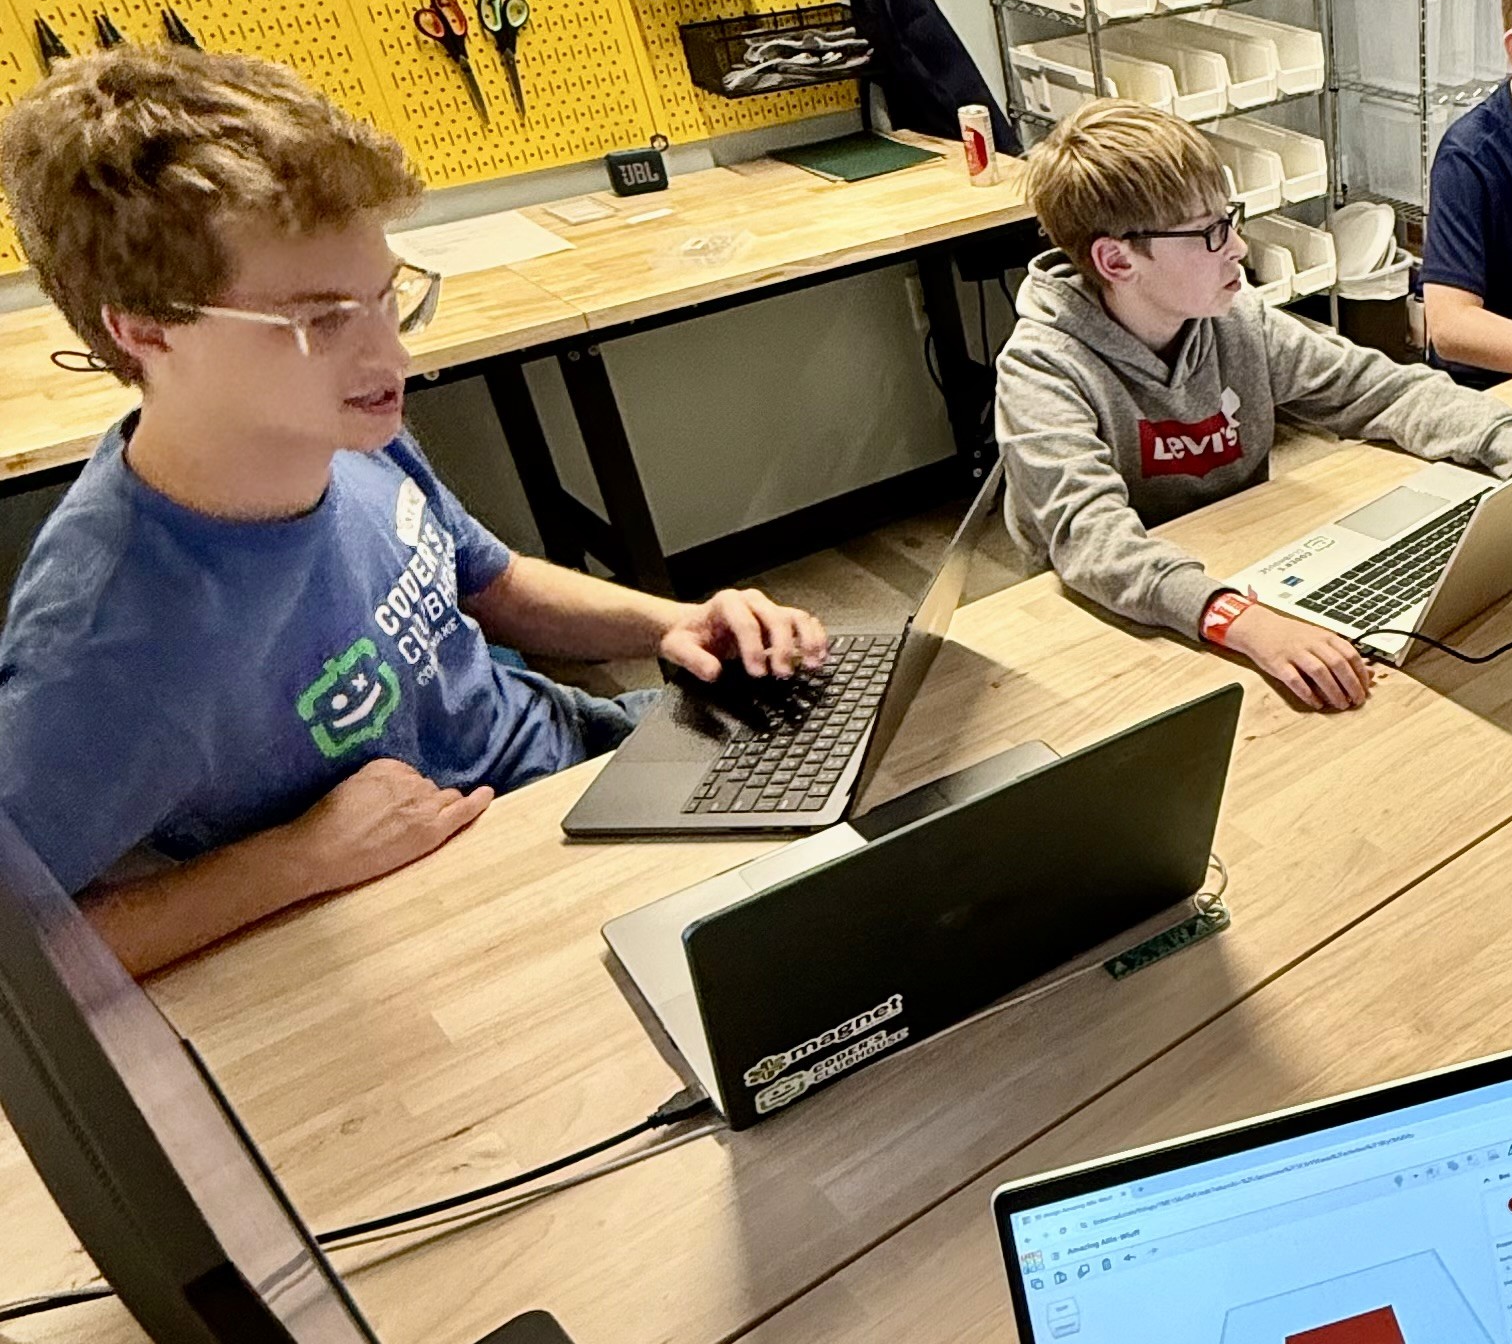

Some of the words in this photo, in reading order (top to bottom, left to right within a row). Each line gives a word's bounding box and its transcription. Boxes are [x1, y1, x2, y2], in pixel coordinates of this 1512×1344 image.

[618, 161, 660, 187] JBL
[789, 997, 900, 1061] magnet
[812, 1031, 886, 1073] CODER'S
